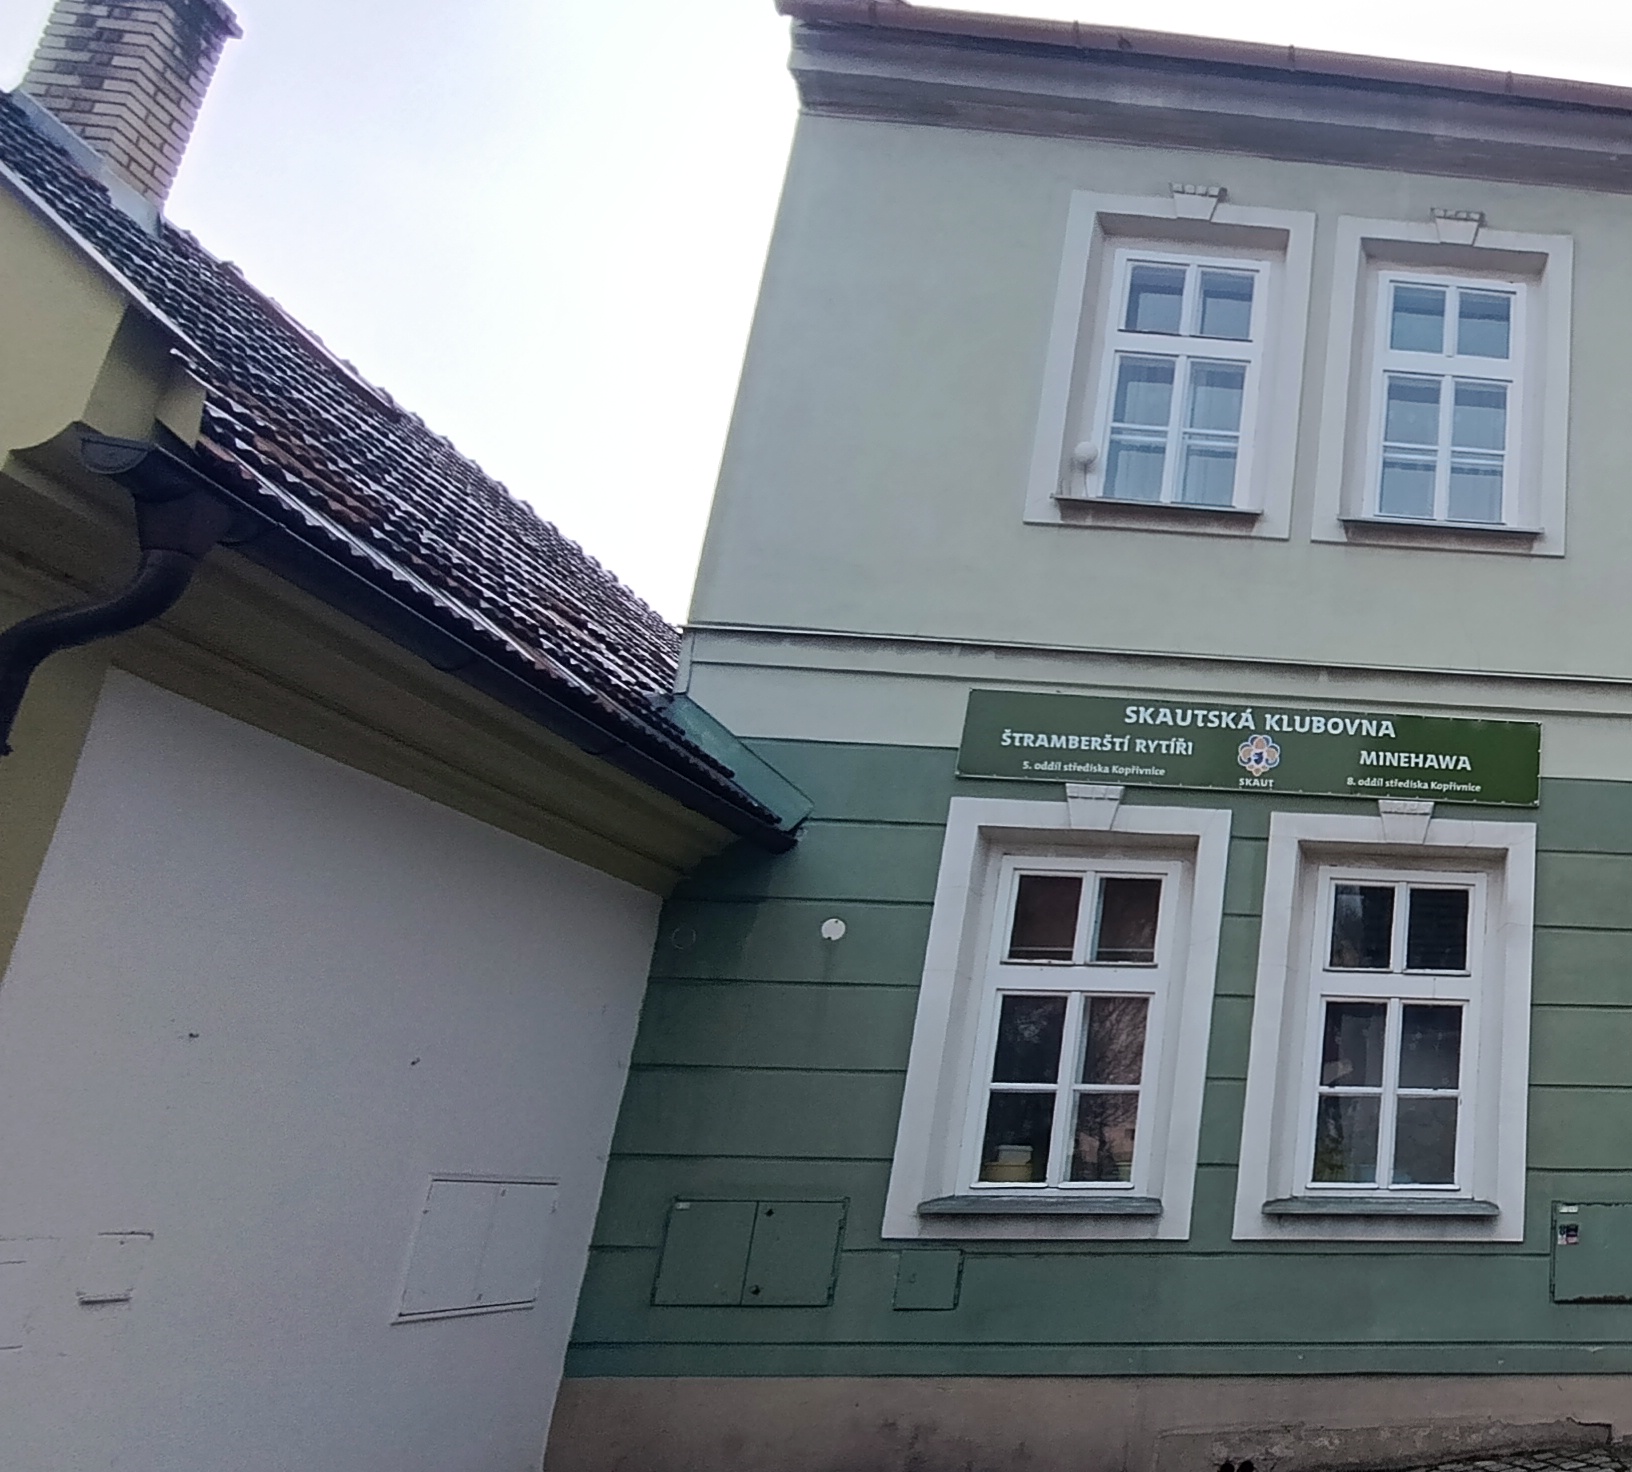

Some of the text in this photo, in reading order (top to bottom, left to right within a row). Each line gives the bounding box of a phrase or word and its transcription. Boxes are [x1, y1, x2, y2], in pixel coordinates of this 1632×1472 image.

[1124, 705, 1396, 738] SKAUTSKÁ KLUBOVNA
[1000, 729, 1194, 756] ŠTRAMBERŠTÍ RYTÍŘI
[1022, 760, 1166, 777] 5. oddíl střediska Kopřivnice
[1359, 750, 1472, 771] MINEHAWA
[1238, 777, 1275, 788] SKAUT
[1346, 777, 1482, 794] 8. oddíl střediska Kopřivnice
